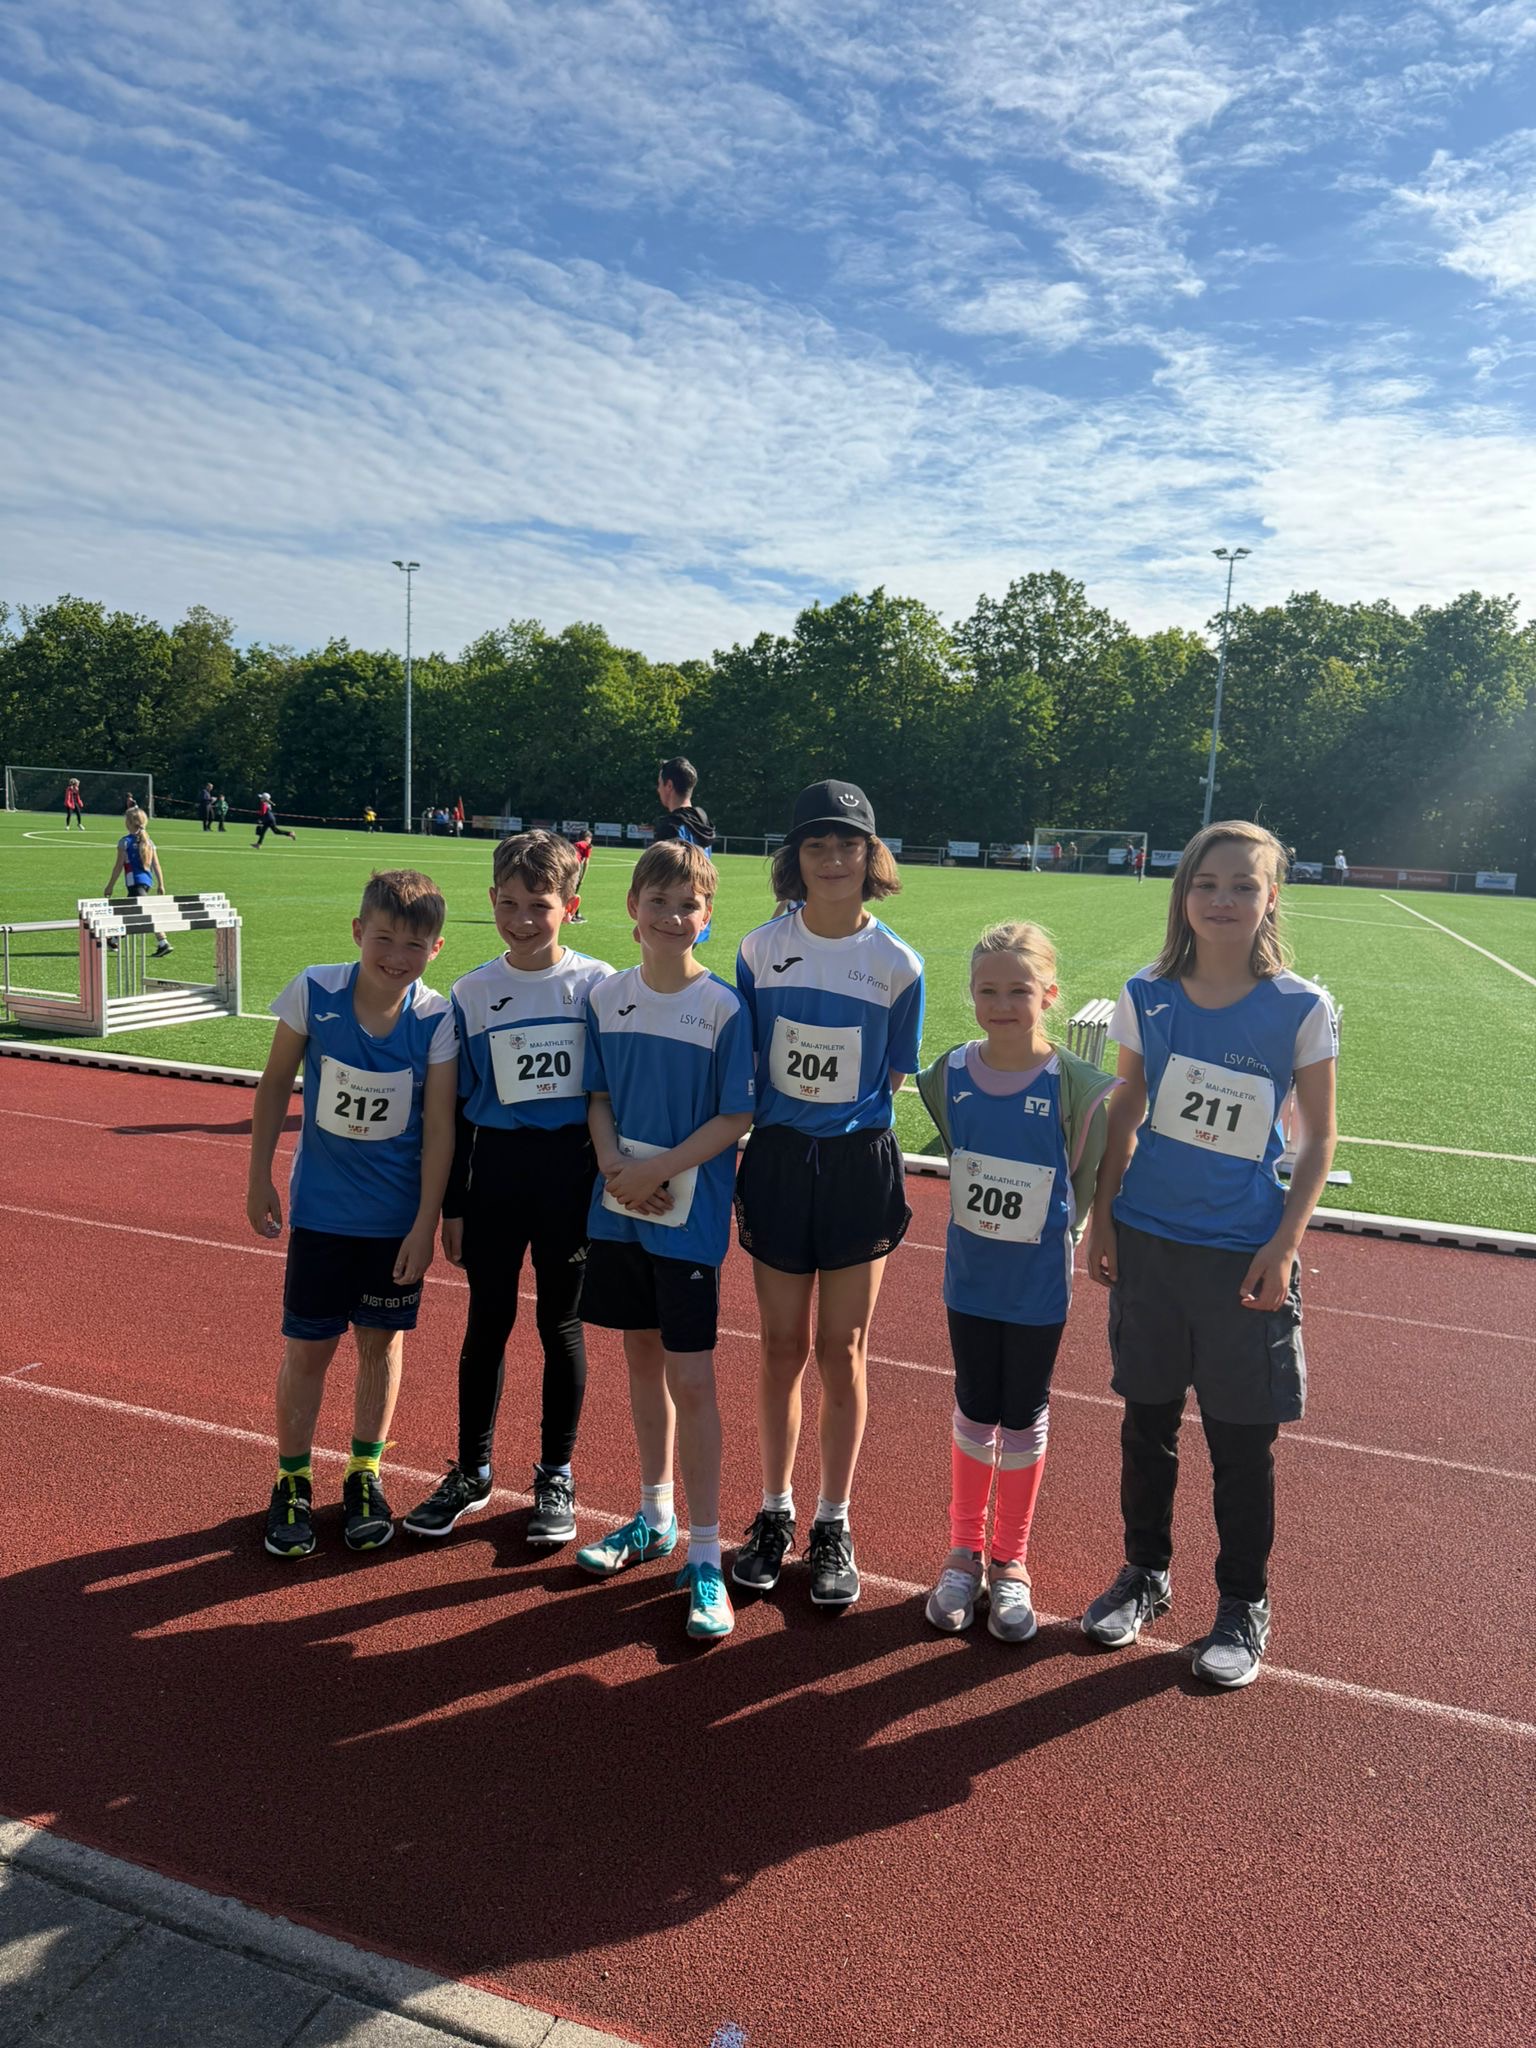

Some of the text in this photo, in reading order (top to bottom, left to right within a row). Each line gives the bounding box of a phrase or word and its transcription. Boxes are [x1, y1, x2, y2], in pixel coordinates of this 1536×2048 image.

[848, 969, 889, 991] LSV Pirna
[563, 996, 578, 1005] LSV
[680, 1014, 697, 1025] LSV
[529, 1039, 575, 1049] MAI-ATHLETIK
[800, 1041, 845, 1051] MAI-ATHLETIK
[517, 1050, 571, 1081] 220
[1224, 1052, 1244, 1065] LSV
[787, 1050, 838, 1082] 204
[350, 1083, 396, 1094] MAI-ATHLETIK
[1205, 1082, 1256, 1102] MAI-ATHLETIK
[334, 1091, 389, 1122] 212
[1180, 1091, 1242, 1133] 211
[983, 1174, 1031, 1188] MAI-ATHLETIK
[967, 1183, 1023, 1220] 208
[385, 1297, 400, 1308] GO
